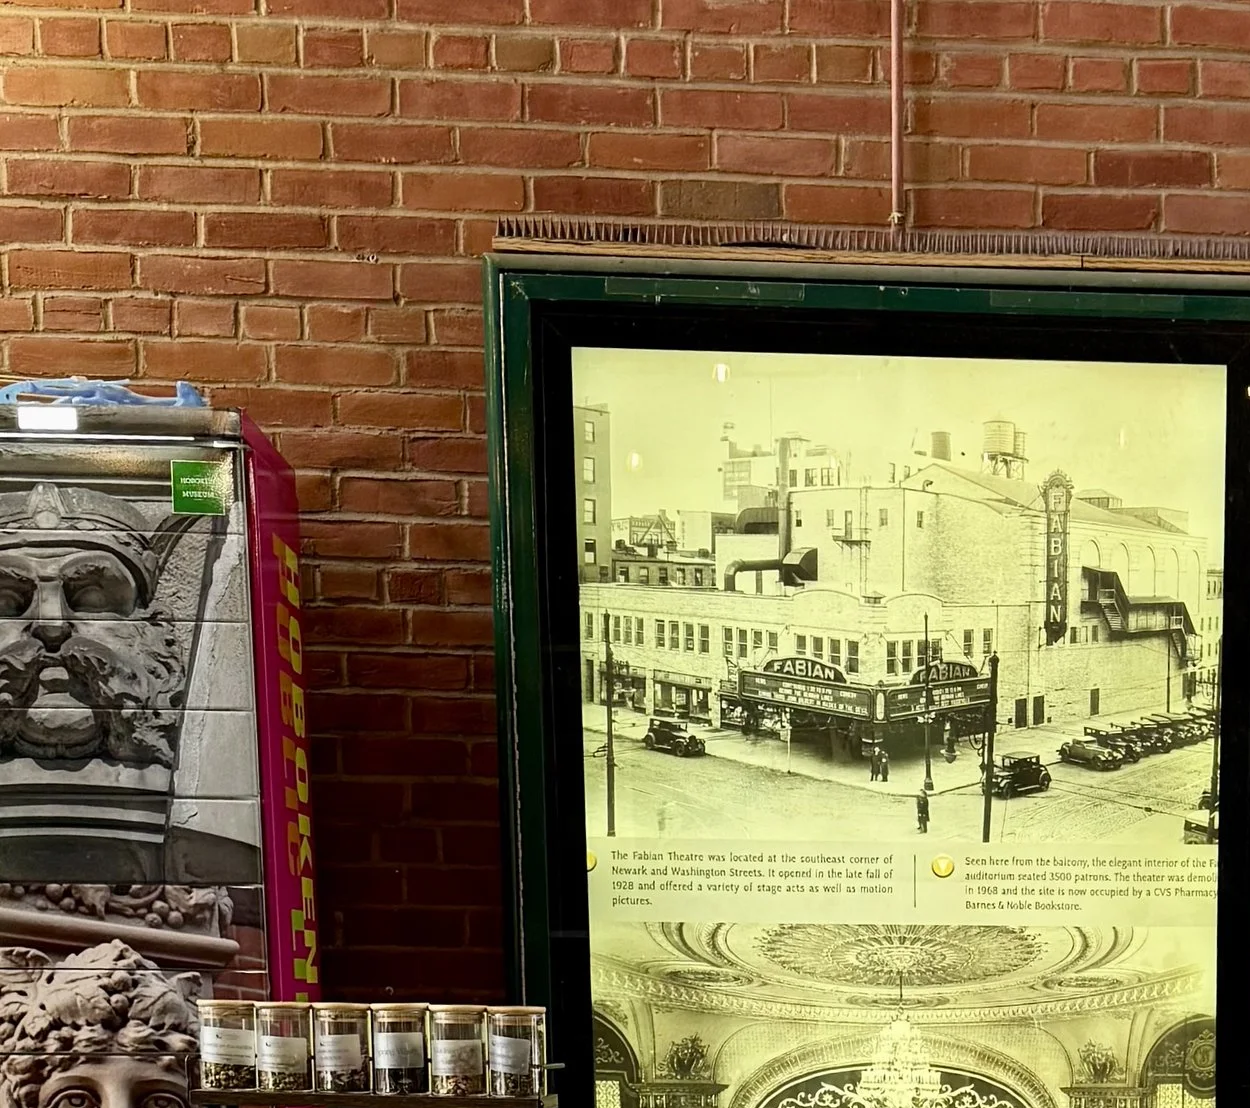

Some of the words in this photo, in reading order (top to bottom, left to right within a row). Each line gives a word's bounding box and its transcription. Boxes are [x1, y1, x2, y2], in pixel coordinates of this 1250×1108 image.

[1050, 491, 1064, 623] FABIAN
[774, 660, 834, 680] FABIAN
[920, 664, 970, 682] FABIAN
[611, 851, 628, 861] The
[633, 851, 663, 861] Fabian
[668, 852, 703, 862] Theatre
[708, 854, 725, 862] was
[730, 852, 763, 862] located
[768, 853, 776, 862] at
[782, 852, 796, 863] the
[801, 853, 845, 863] southeast
[850, 856, 879, 864] corner
[883, 854, 893, 864] of
[612, 866, 648, 876] Newark
[651, 867, 667, 876] and
[671, 867, 726, 879] Washington
[730, 867, 765, 877] Streets.
[768, 868, 775, 878] It
[779, 869, 811, 881] opened
[815, 869, 824, 878] in
[827, 869, 842, 878] the
[846, 869, 863, 878] late
[866, 869, 880, 879] fall
[884, 869, 893, 879] of
[965, 872, 1015, 881] auditorium
[1018, 872, 1046, 881] seated
[1050, 872, 1071, 882] 3500
[1075, 873, 1111, 884] patrons.
[1114, 873, 1130, 882] The
[1133, 873, 1164, 882] theater
[612, 881, 634, 891] 1928
[638, 882, 655, 891] and
[660, 882, 693, 891] offered
[707, 882, 739, 893] variety
[744, 883, 752, 892] of
[757, 884, 781, 894] stage
[786, 884, 805, 892] acts
[823, 884, 841, 893] well
[860, 884, 893, 893] motion
[612, 896, 652, 907] pictures.
[966, 902, 996, 910] Barnes
[998, 902, 1004, 910] &
[1007, 902, 1032, 910] Noble
[1035, 902, 1082, 911] Bookstore.
